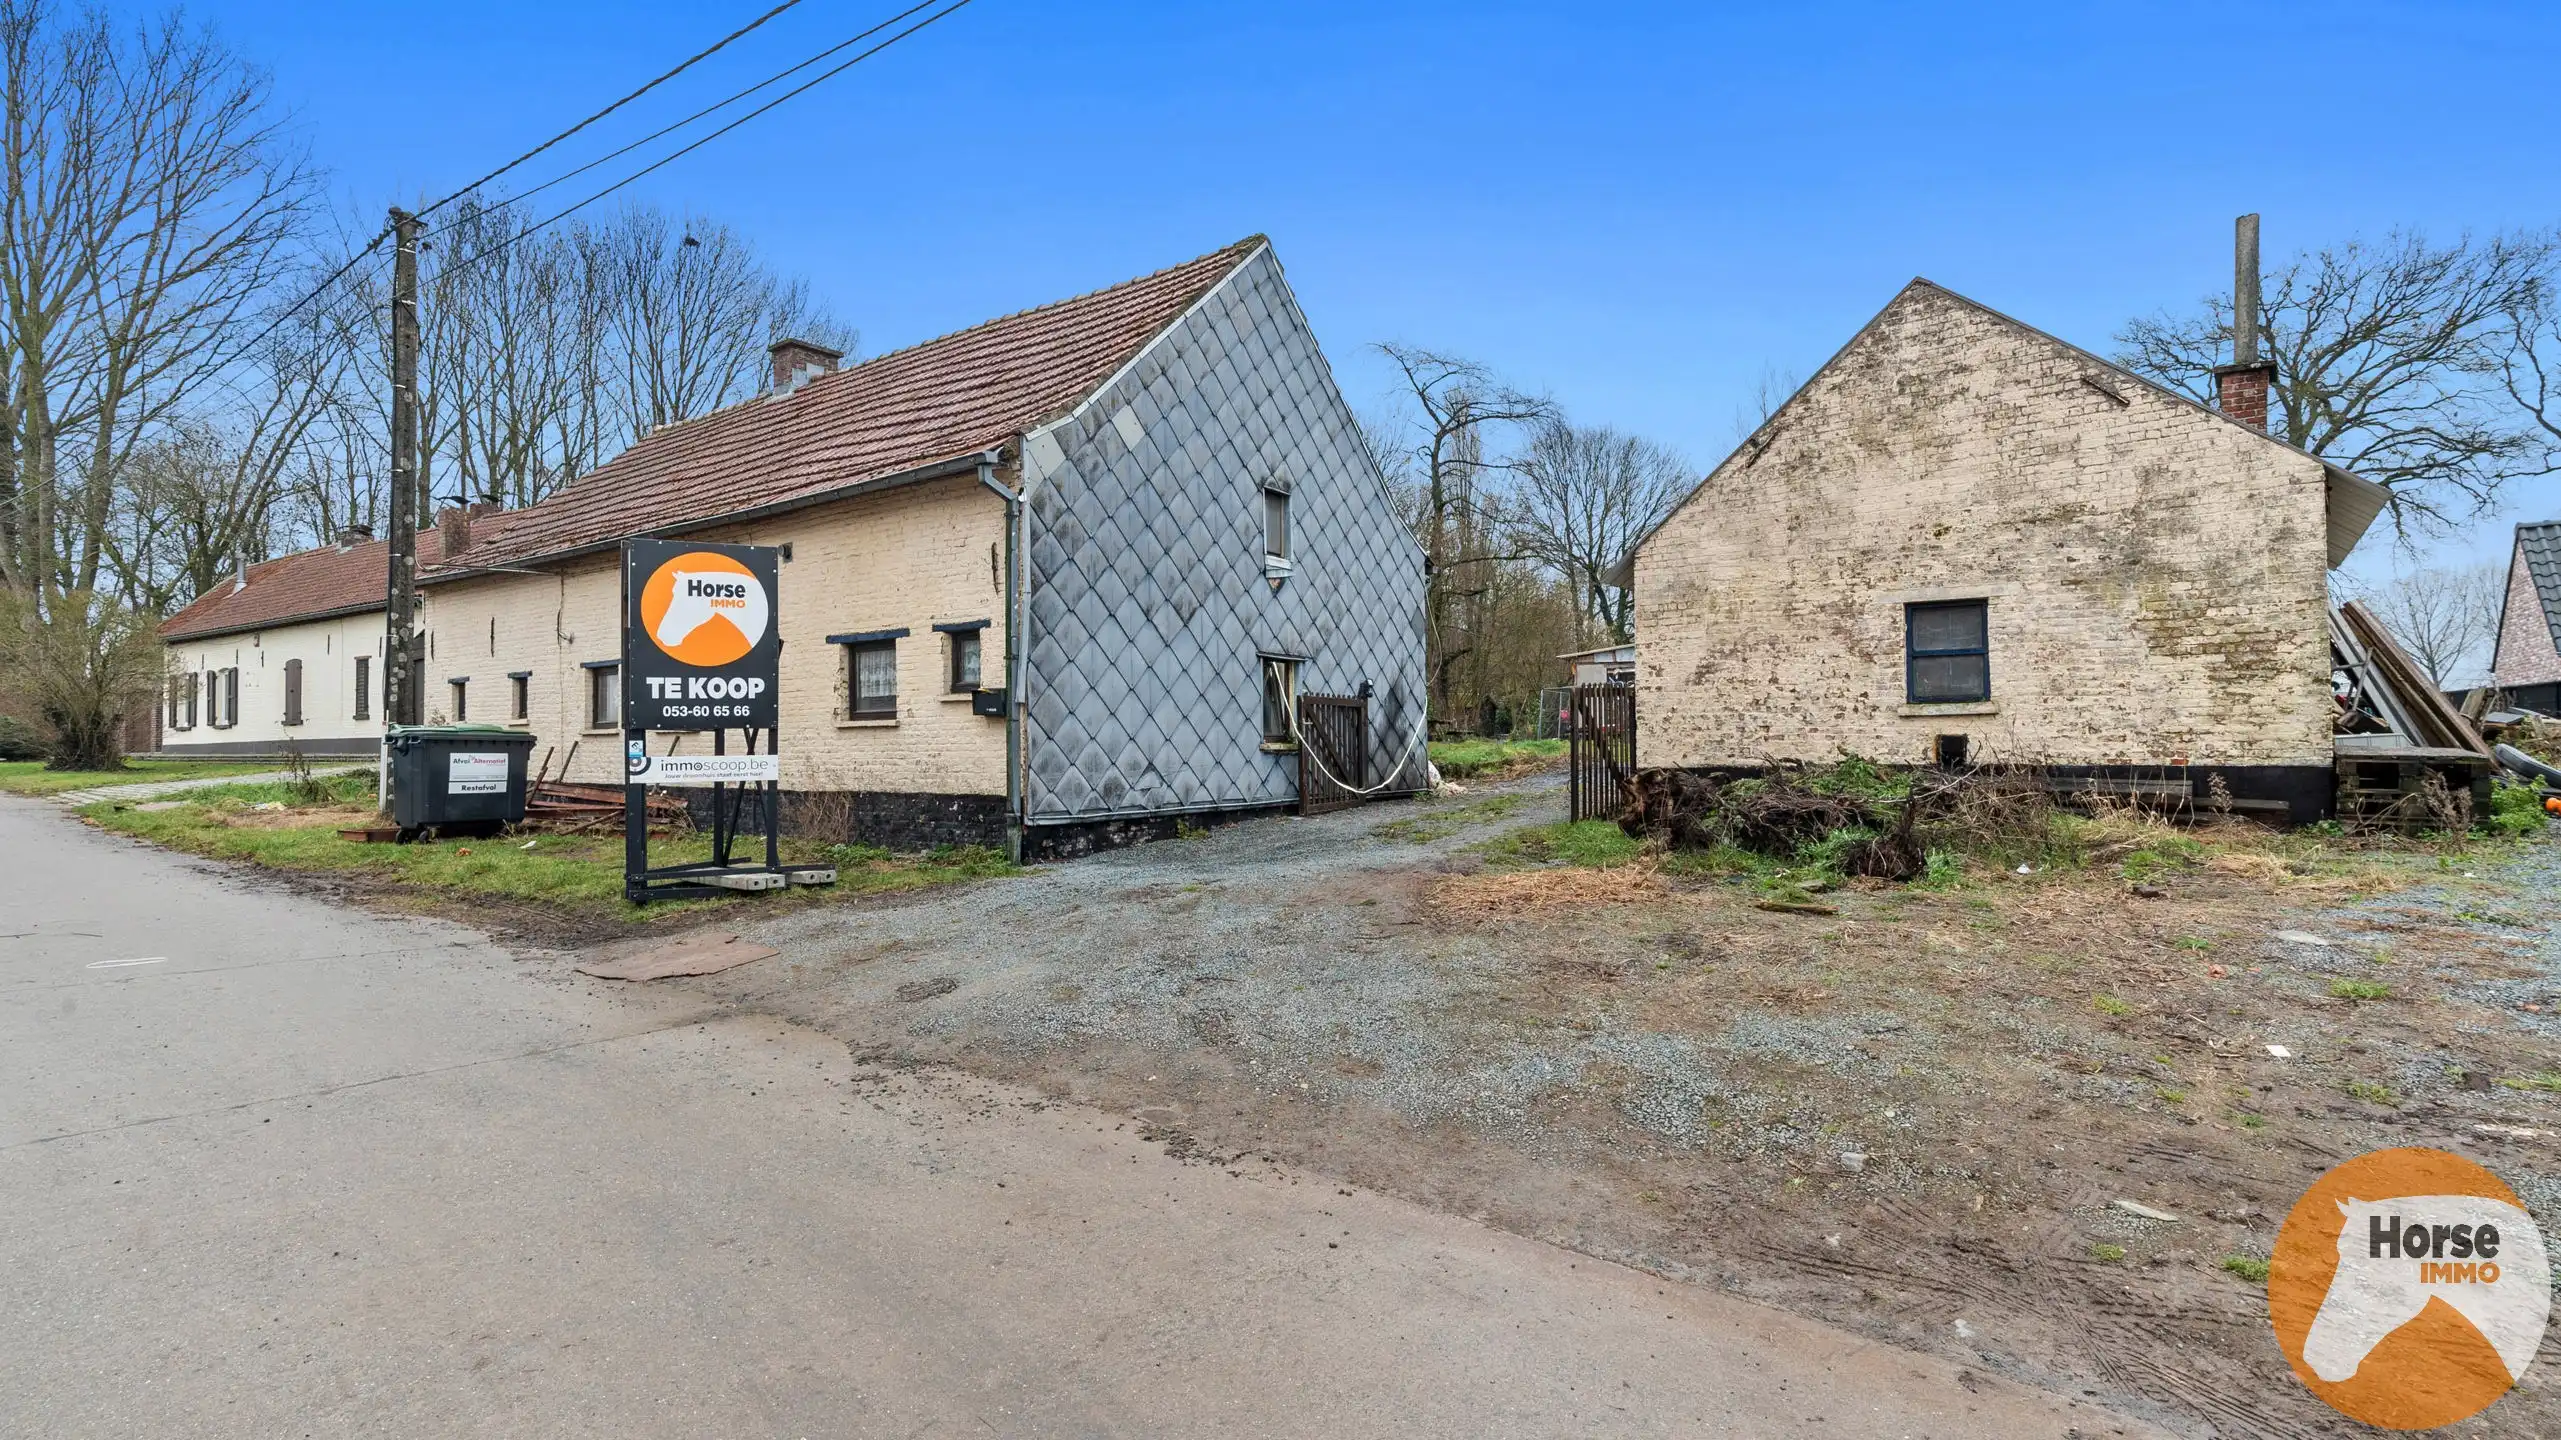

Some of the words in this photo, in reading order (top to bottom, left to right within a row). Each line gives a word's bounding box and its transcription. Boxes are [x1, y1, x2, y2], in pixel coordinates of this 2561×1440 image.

[688, 579, 746, 598] Horse
[710, 599, 746, 608] IMMO
[646, 677, 682, 699] TE
[688, 677, 765, 699] KOOP
[662, 705, 710, 717] 053-60
[713, 705, 730, 717] 65
[733, 705, 750, 717] 66
[660, 759, 768, 774] immoscoop.be
